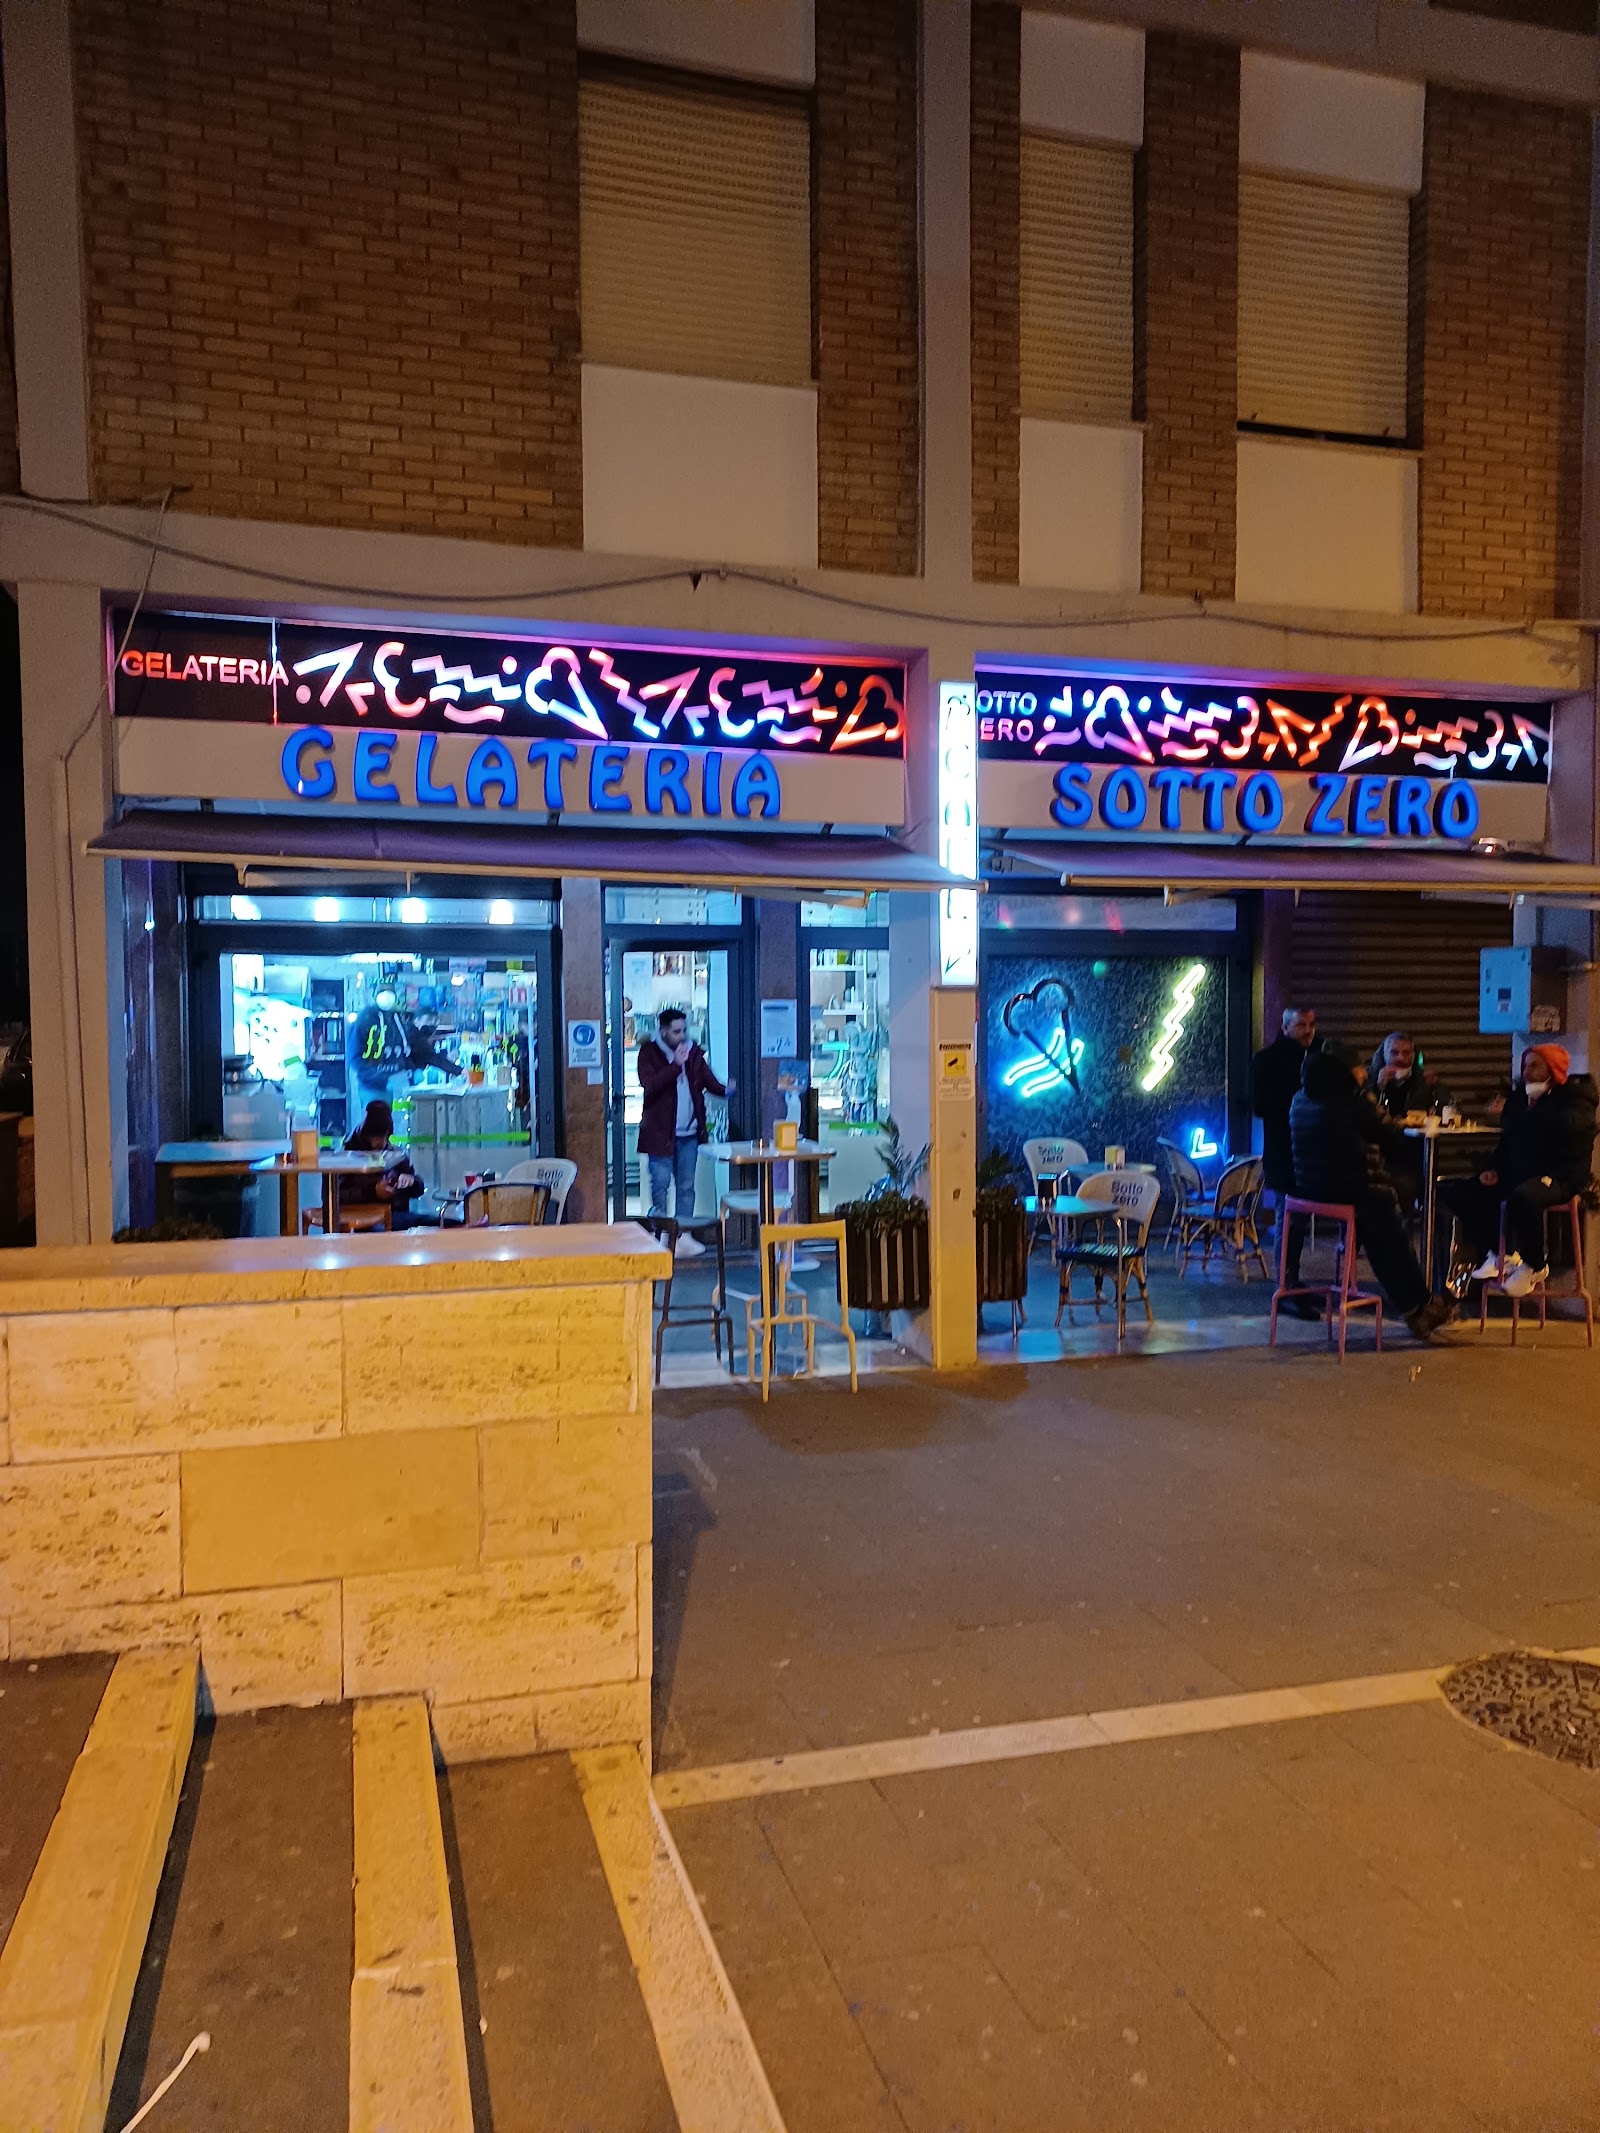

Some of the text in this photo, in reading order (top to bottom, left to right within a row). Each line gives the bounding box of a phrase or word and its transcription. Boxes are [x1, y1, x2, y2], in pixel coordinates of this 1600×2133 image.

[121, 650, 289, 686] GELATERIA
[976, 690, 1037, 715] OTTO
[980, 717, 1034, 742] ERO
[280, 725, 781, 817] GELATERIA
[1050, 762, 1479, 839] SOTTO ZERO
